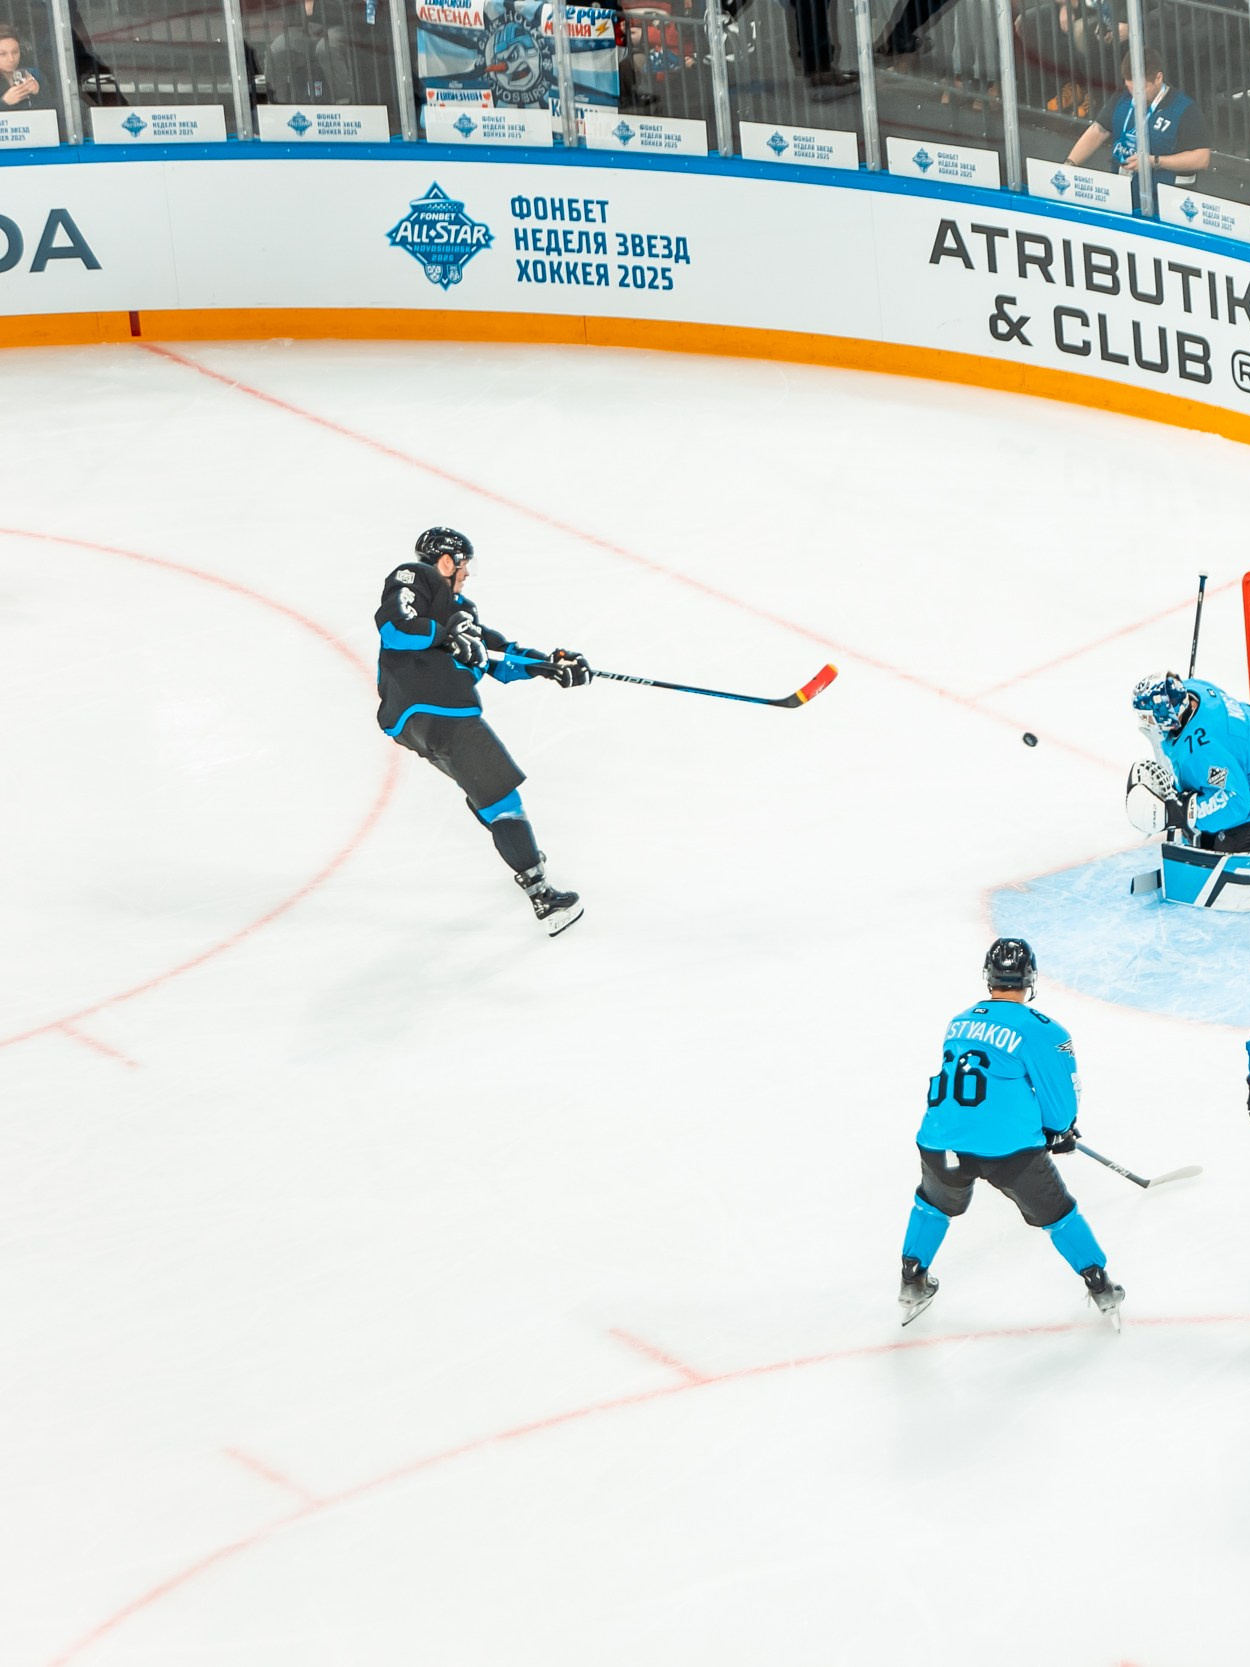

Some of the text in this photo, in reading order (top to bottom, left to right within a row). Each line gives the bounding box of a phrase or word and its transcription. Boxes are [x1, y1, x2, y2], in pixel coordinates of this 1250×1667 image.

[1153, 116, 1171, 133] 57
[420, 212, 456, 221] FONBET
[510, 195, 609, 223] ФОНБЕТ
[514, 227, 691, 264] НЕДЕЛЯ ЗВЕЗД
[516, 259, 674, 290] ХОККЕЯ 2025
[989, 294, 1033, 347] &
[1053, 304, 1213, 385] CLUB
[1184, 727, 1211, 754] 72
[947, 1020, 1023, 1054] STYAKOV
